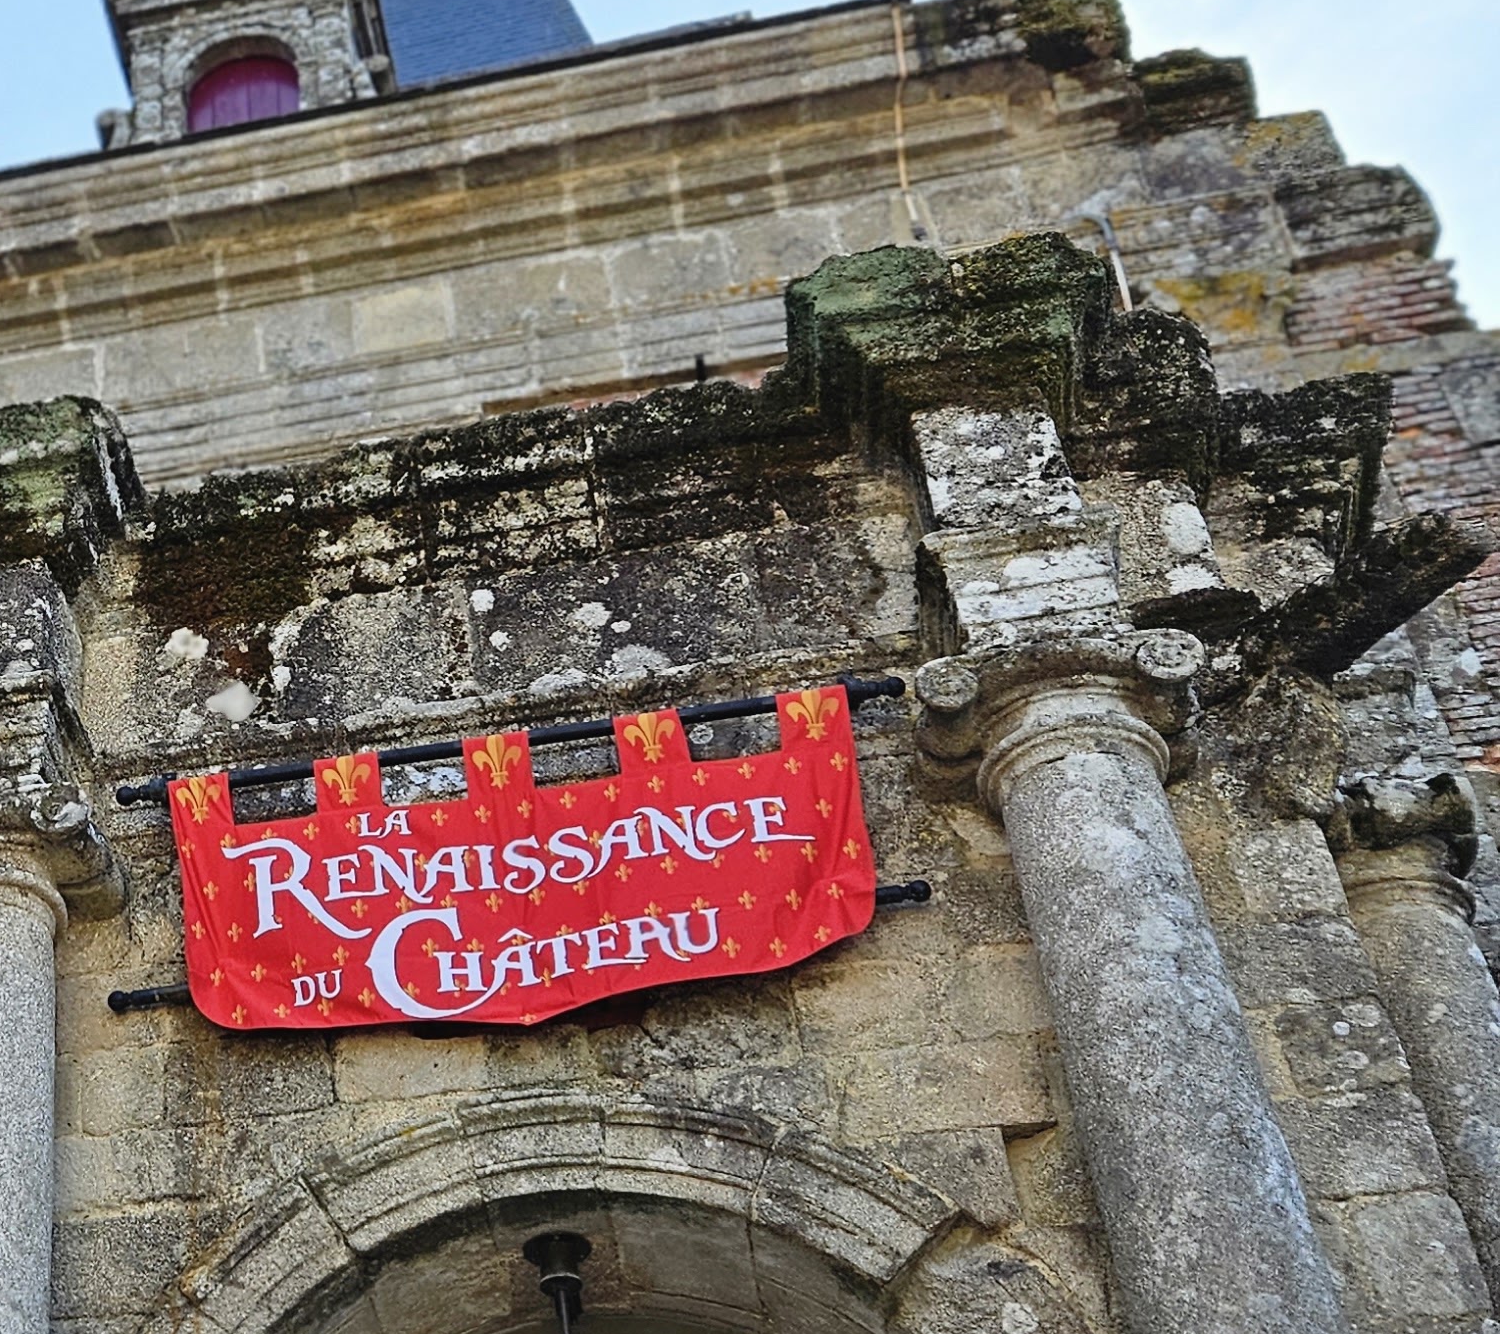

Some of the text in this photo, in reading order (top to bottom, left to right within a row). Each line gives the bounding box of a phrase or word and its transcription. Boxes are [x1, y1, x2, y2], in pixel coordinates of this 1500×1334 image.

[356, 809, 412, 839] LA
[221, 795, 817, 941] RENAISSANCE
[291, 968, 343, 1008] DU
